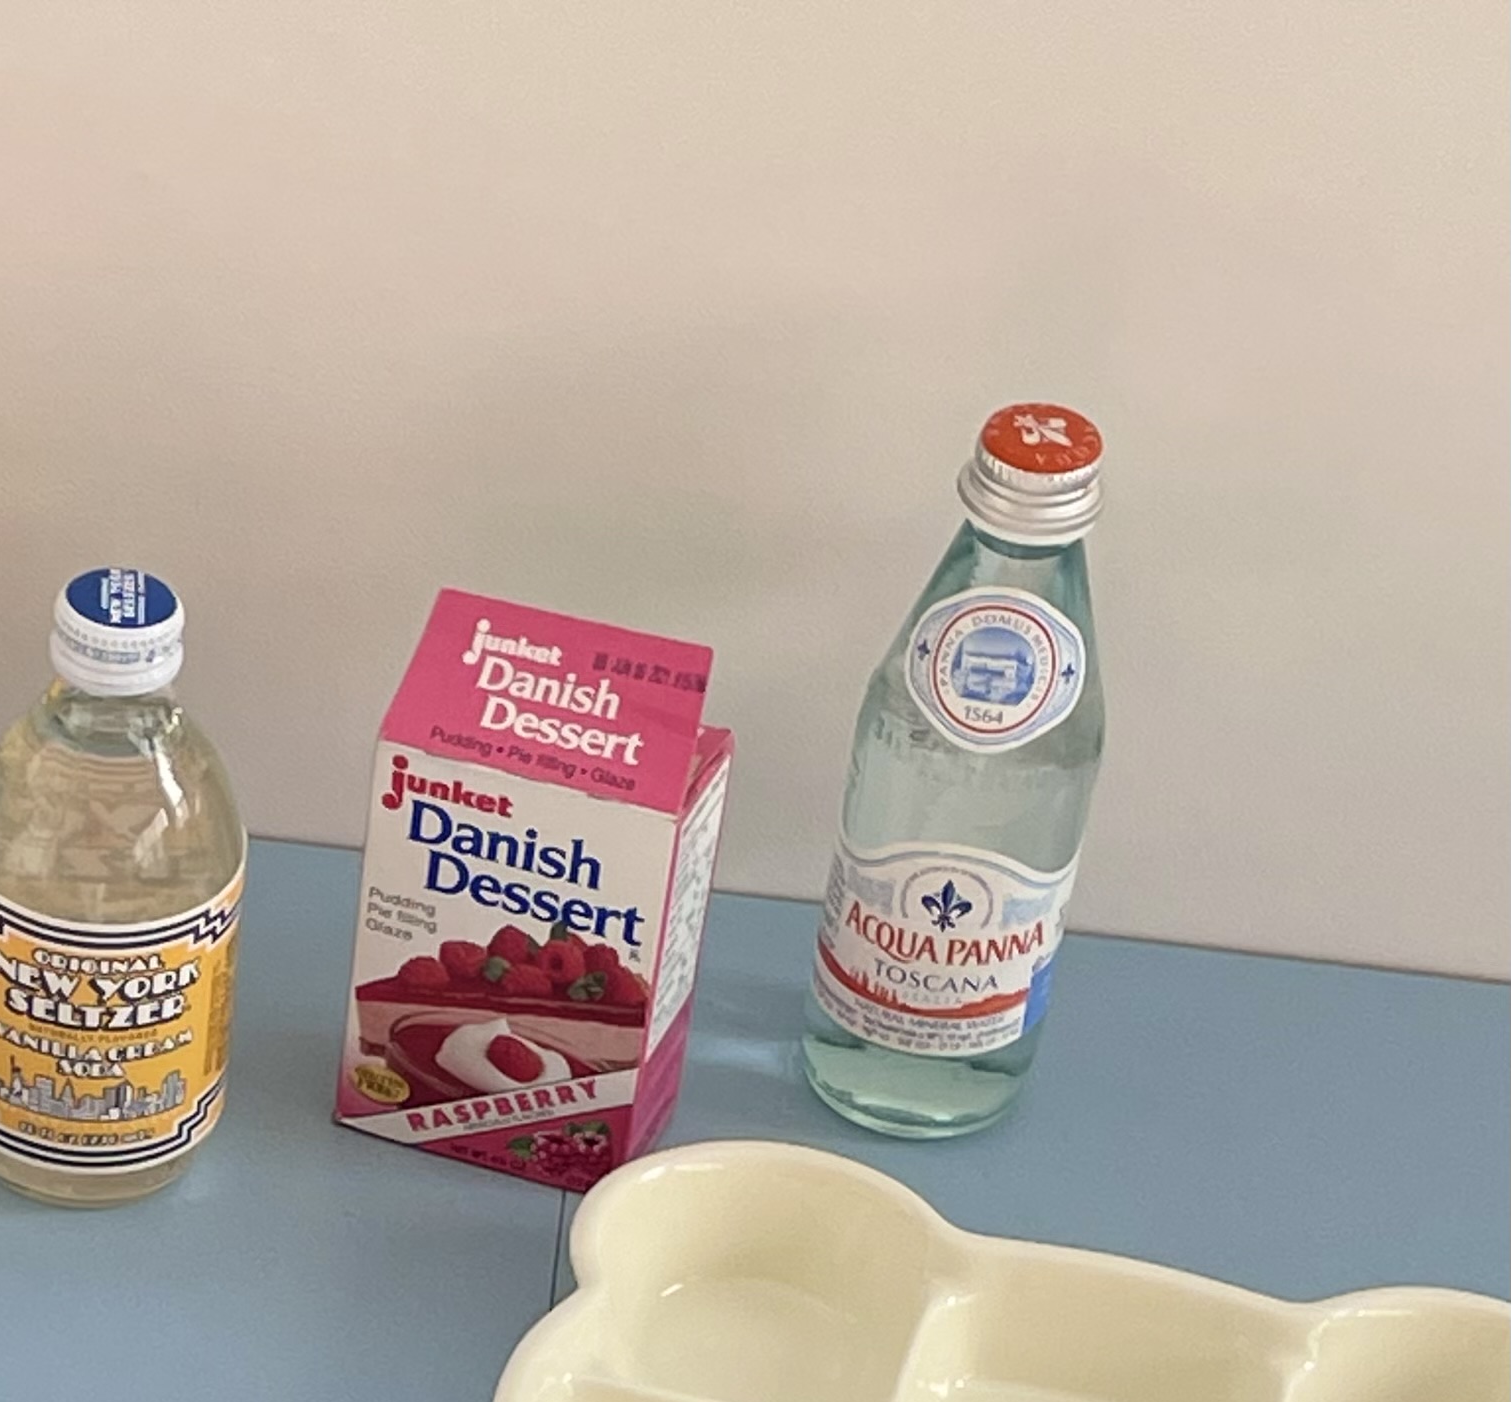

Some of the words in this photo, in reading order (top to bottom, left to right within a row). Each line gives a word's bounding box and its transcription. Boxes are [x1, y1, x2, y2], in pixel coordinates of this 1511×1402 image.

[462, 618, 563, 666] junket
[971, 614, 1033, 636] DOMUS
[476, 655, 622, 720] Danish
[479, 696, 645, 767] Dessert
[963, 704, 1004, 725] 1564
[429, 724, 493, 758] Pudding
[589, 766, 636, 791] Glaze
[381, 755, 513, 819] junket
[406, 799, 602, 892] Danish
[368, 885, 437, 919] Pudding
[423, 848, 646, 948] Dessert
[365, 917, 413, 941] Glaze
[845, 900, 938, 965] ACQUA
[945, 920, 1045, 967] PANNA
[32, 948, 163, 975] ORIGINAL
[91, 959, 201, 1001] YORK
[874, 957, 1000, 994] TOSCANA
[6, 987, 187, 1030] SELTZER
[56, 1059, 126, 1079] SODA
[405, 1079, 597, 1132] RASPBERRY
